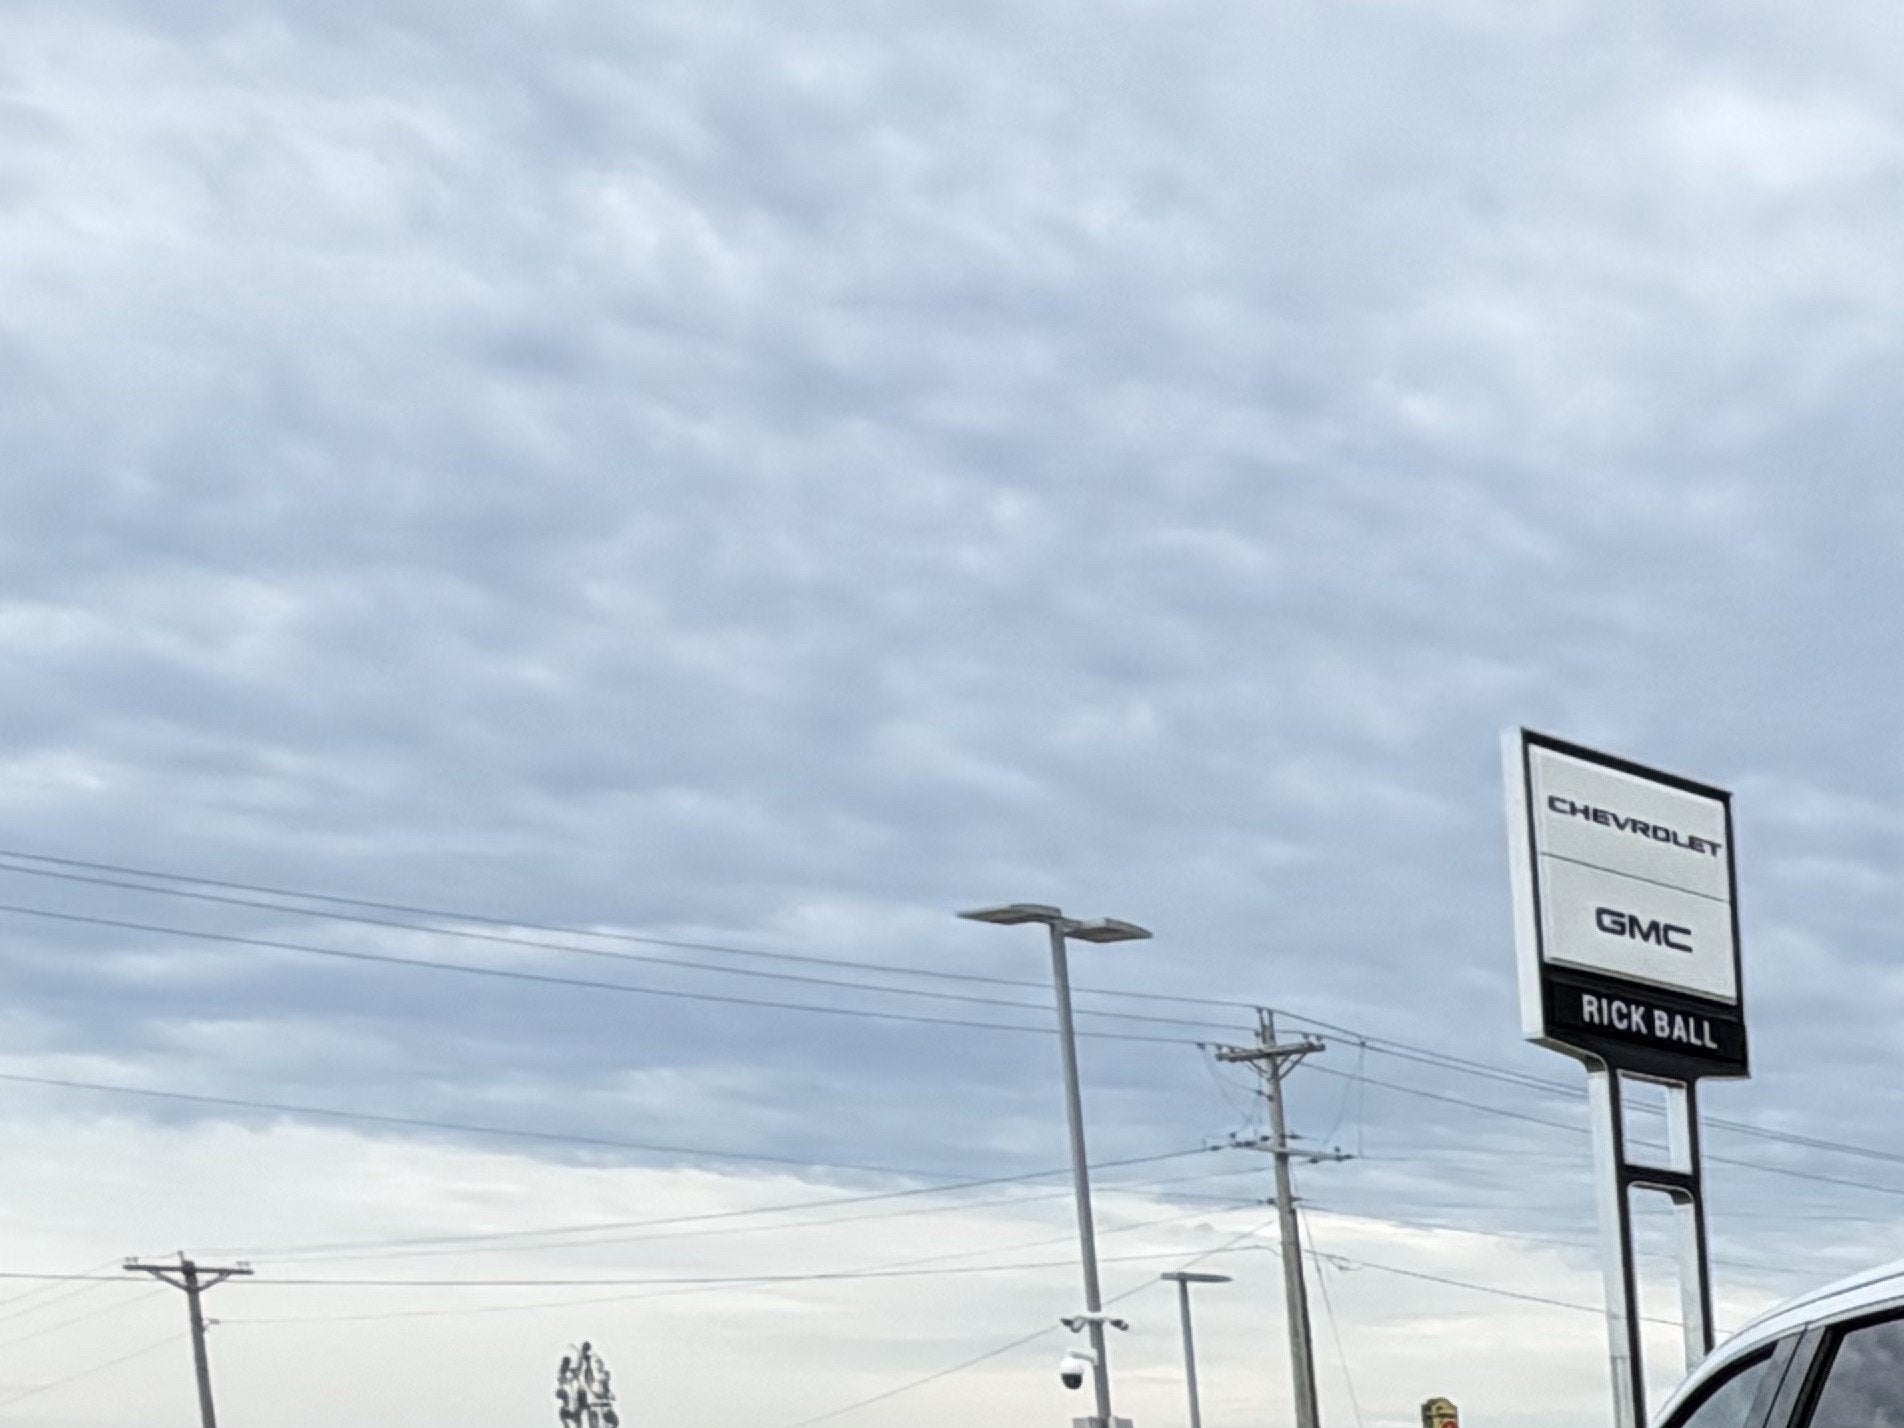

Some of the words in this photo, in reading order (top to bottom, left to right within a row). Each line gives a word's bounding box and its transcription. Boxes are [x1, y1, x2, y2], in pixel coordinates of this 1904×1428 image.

[1547, 795, 1722, 857] CHEVROLET
[1595, 906, 1694, 954] GMC
[1582, 994, 1648, 1035] RICK
[1654, 1009, 1718, 1050] BALL
